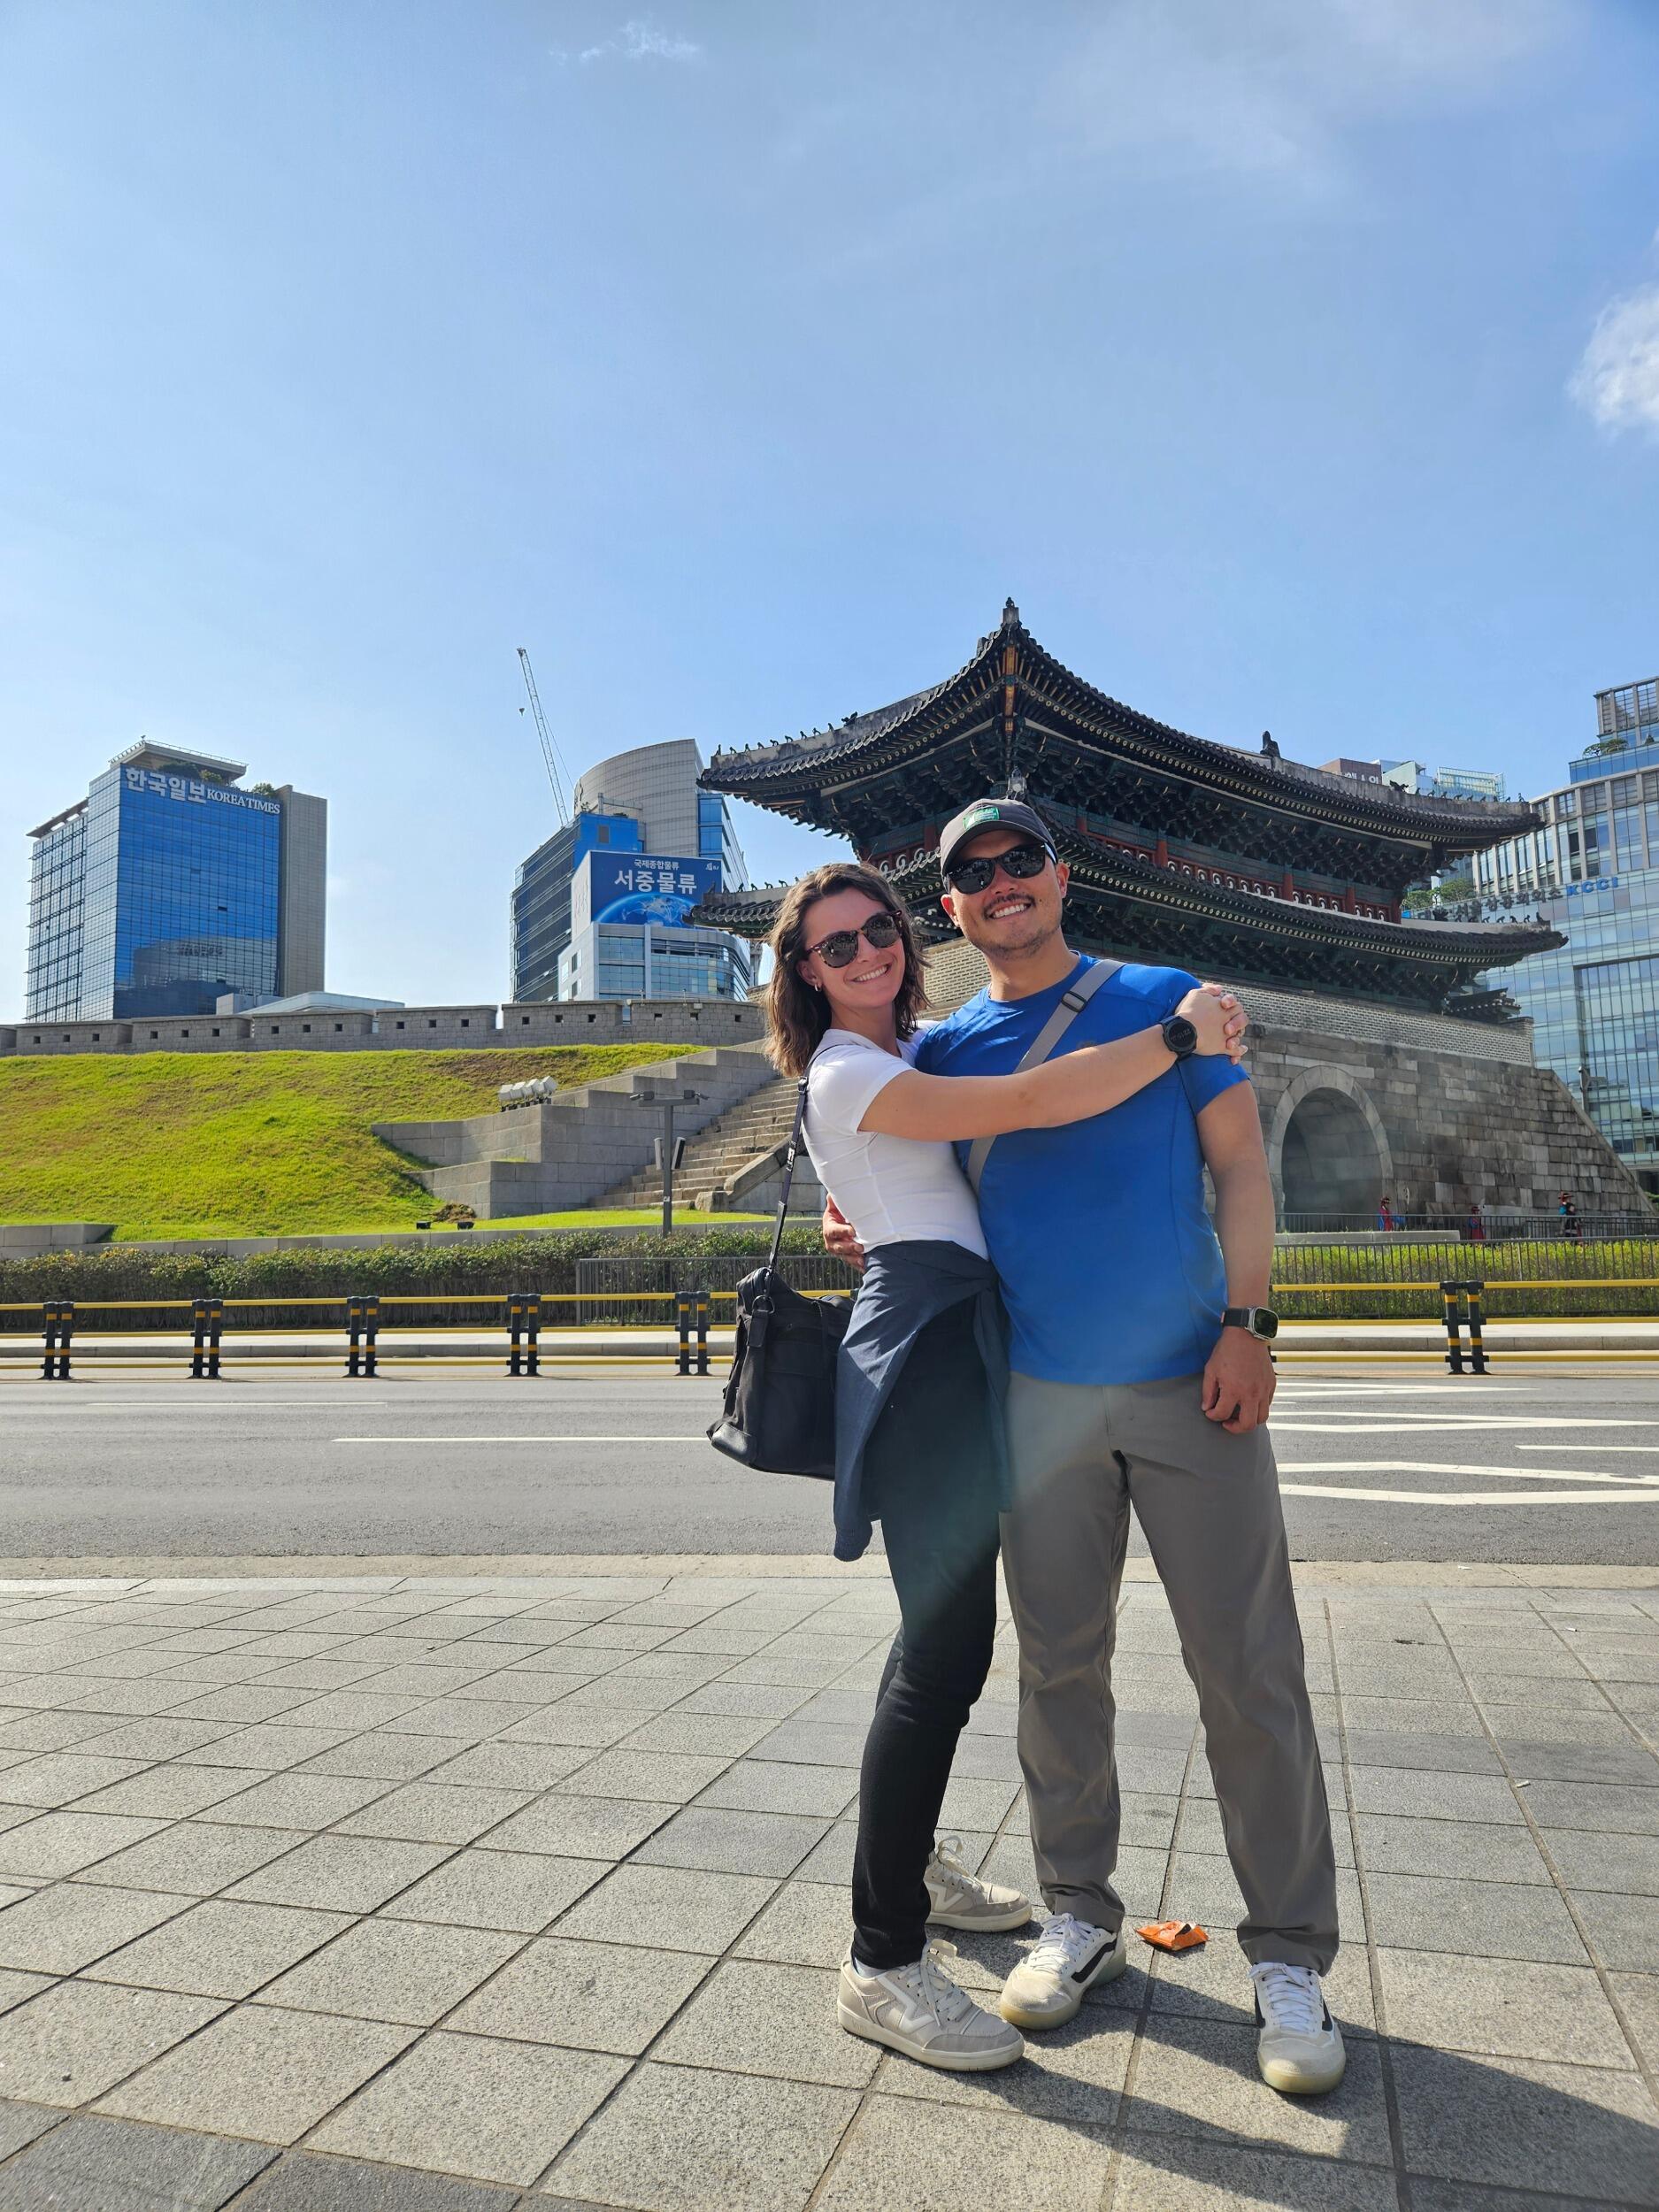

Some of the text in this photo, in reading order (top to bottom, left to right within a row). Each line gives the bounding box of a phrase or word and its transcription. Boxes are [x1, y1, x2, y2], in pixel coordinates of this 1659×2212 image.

[126, 767, 207, 804] 한국일보
[614, 869, 697, 895] 서중물류
[1565, 876, 1619, 896] KCCI
